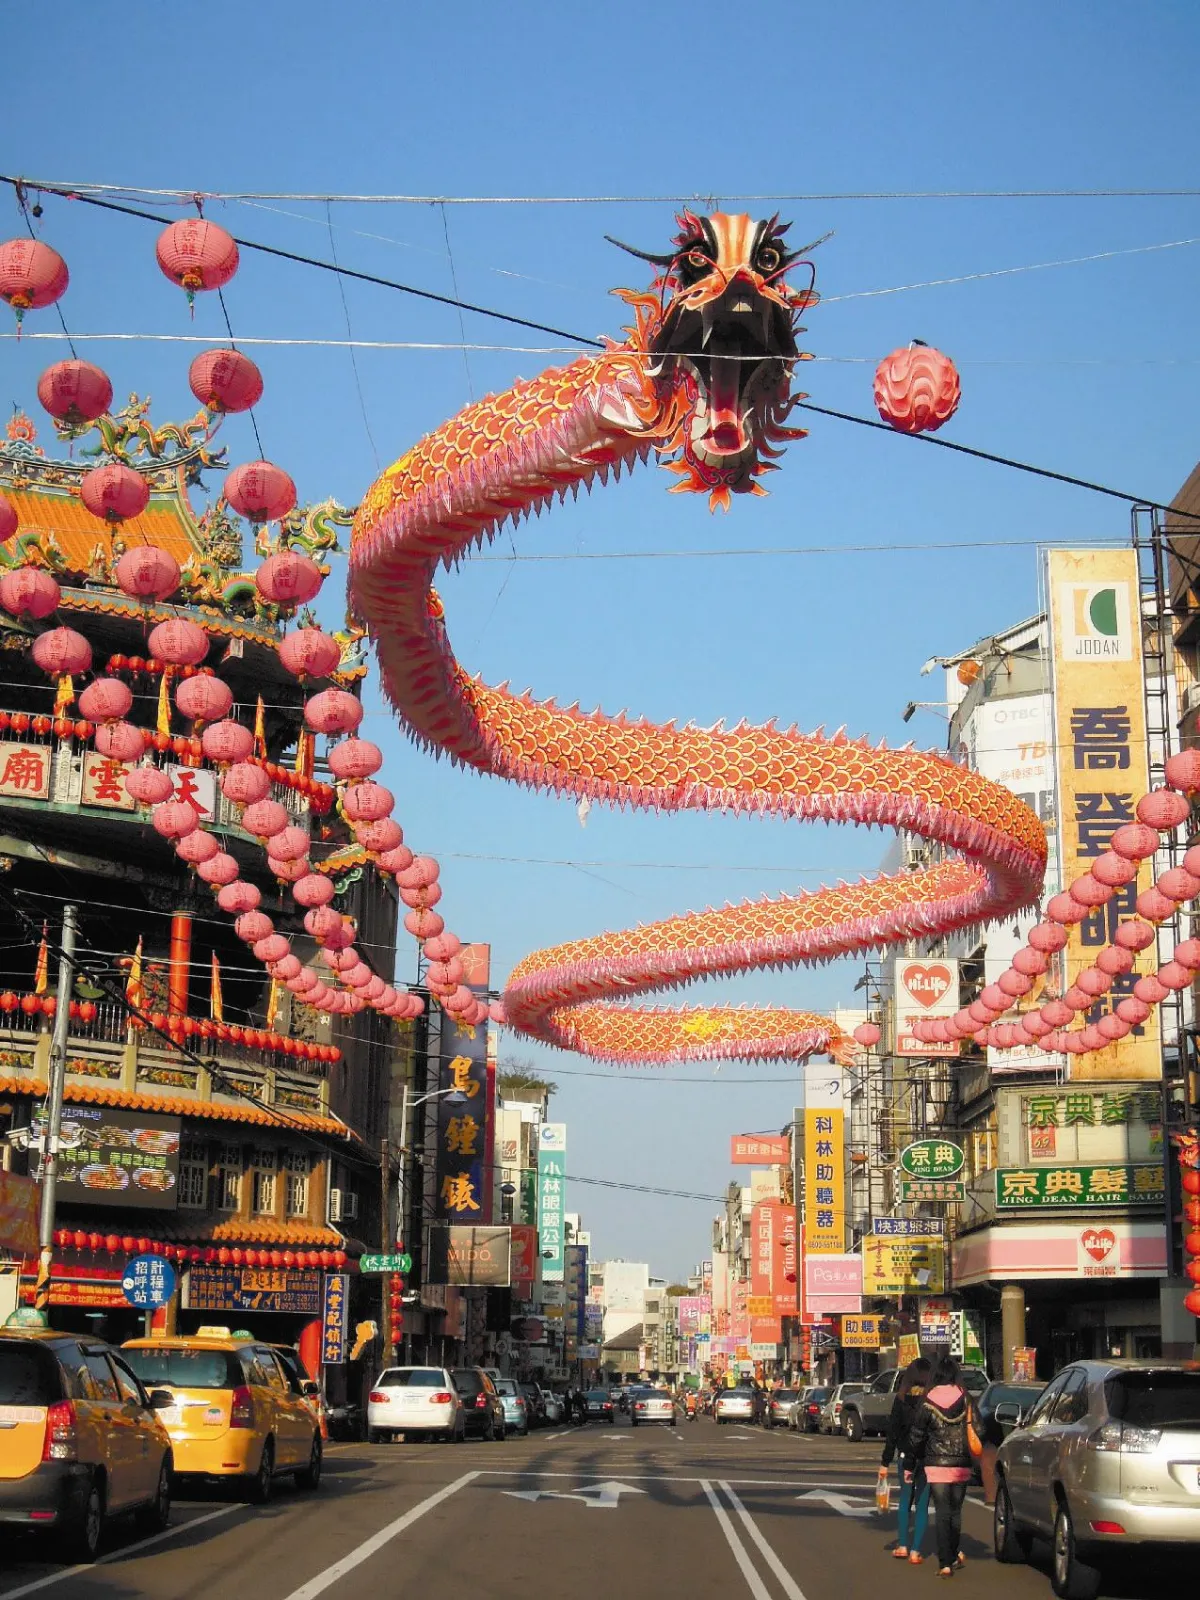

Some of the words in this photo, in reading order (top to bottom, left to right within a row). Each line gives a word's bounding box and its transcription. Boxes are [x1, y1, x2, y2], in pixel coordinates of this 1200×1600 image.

[910, 1145, 955, 1165] 京典
[815, 1116, 834, 1228] 科林助聽器
[541, 1161, 561, 1260] 小林眼鏡公司
[1002, 1196, 1034, 1204] JING
[1041, 1195, 1078, 1203] DEAN
[1085, 1194, 1122, 1202] HAIR
[877, 1220, 940, 1234] 快速照相
[447, 1249, 491, 1261] MIDO
[133, 1261, 148, 1303] 招呼站
[149, 1260, 165, 1303] 計程車
